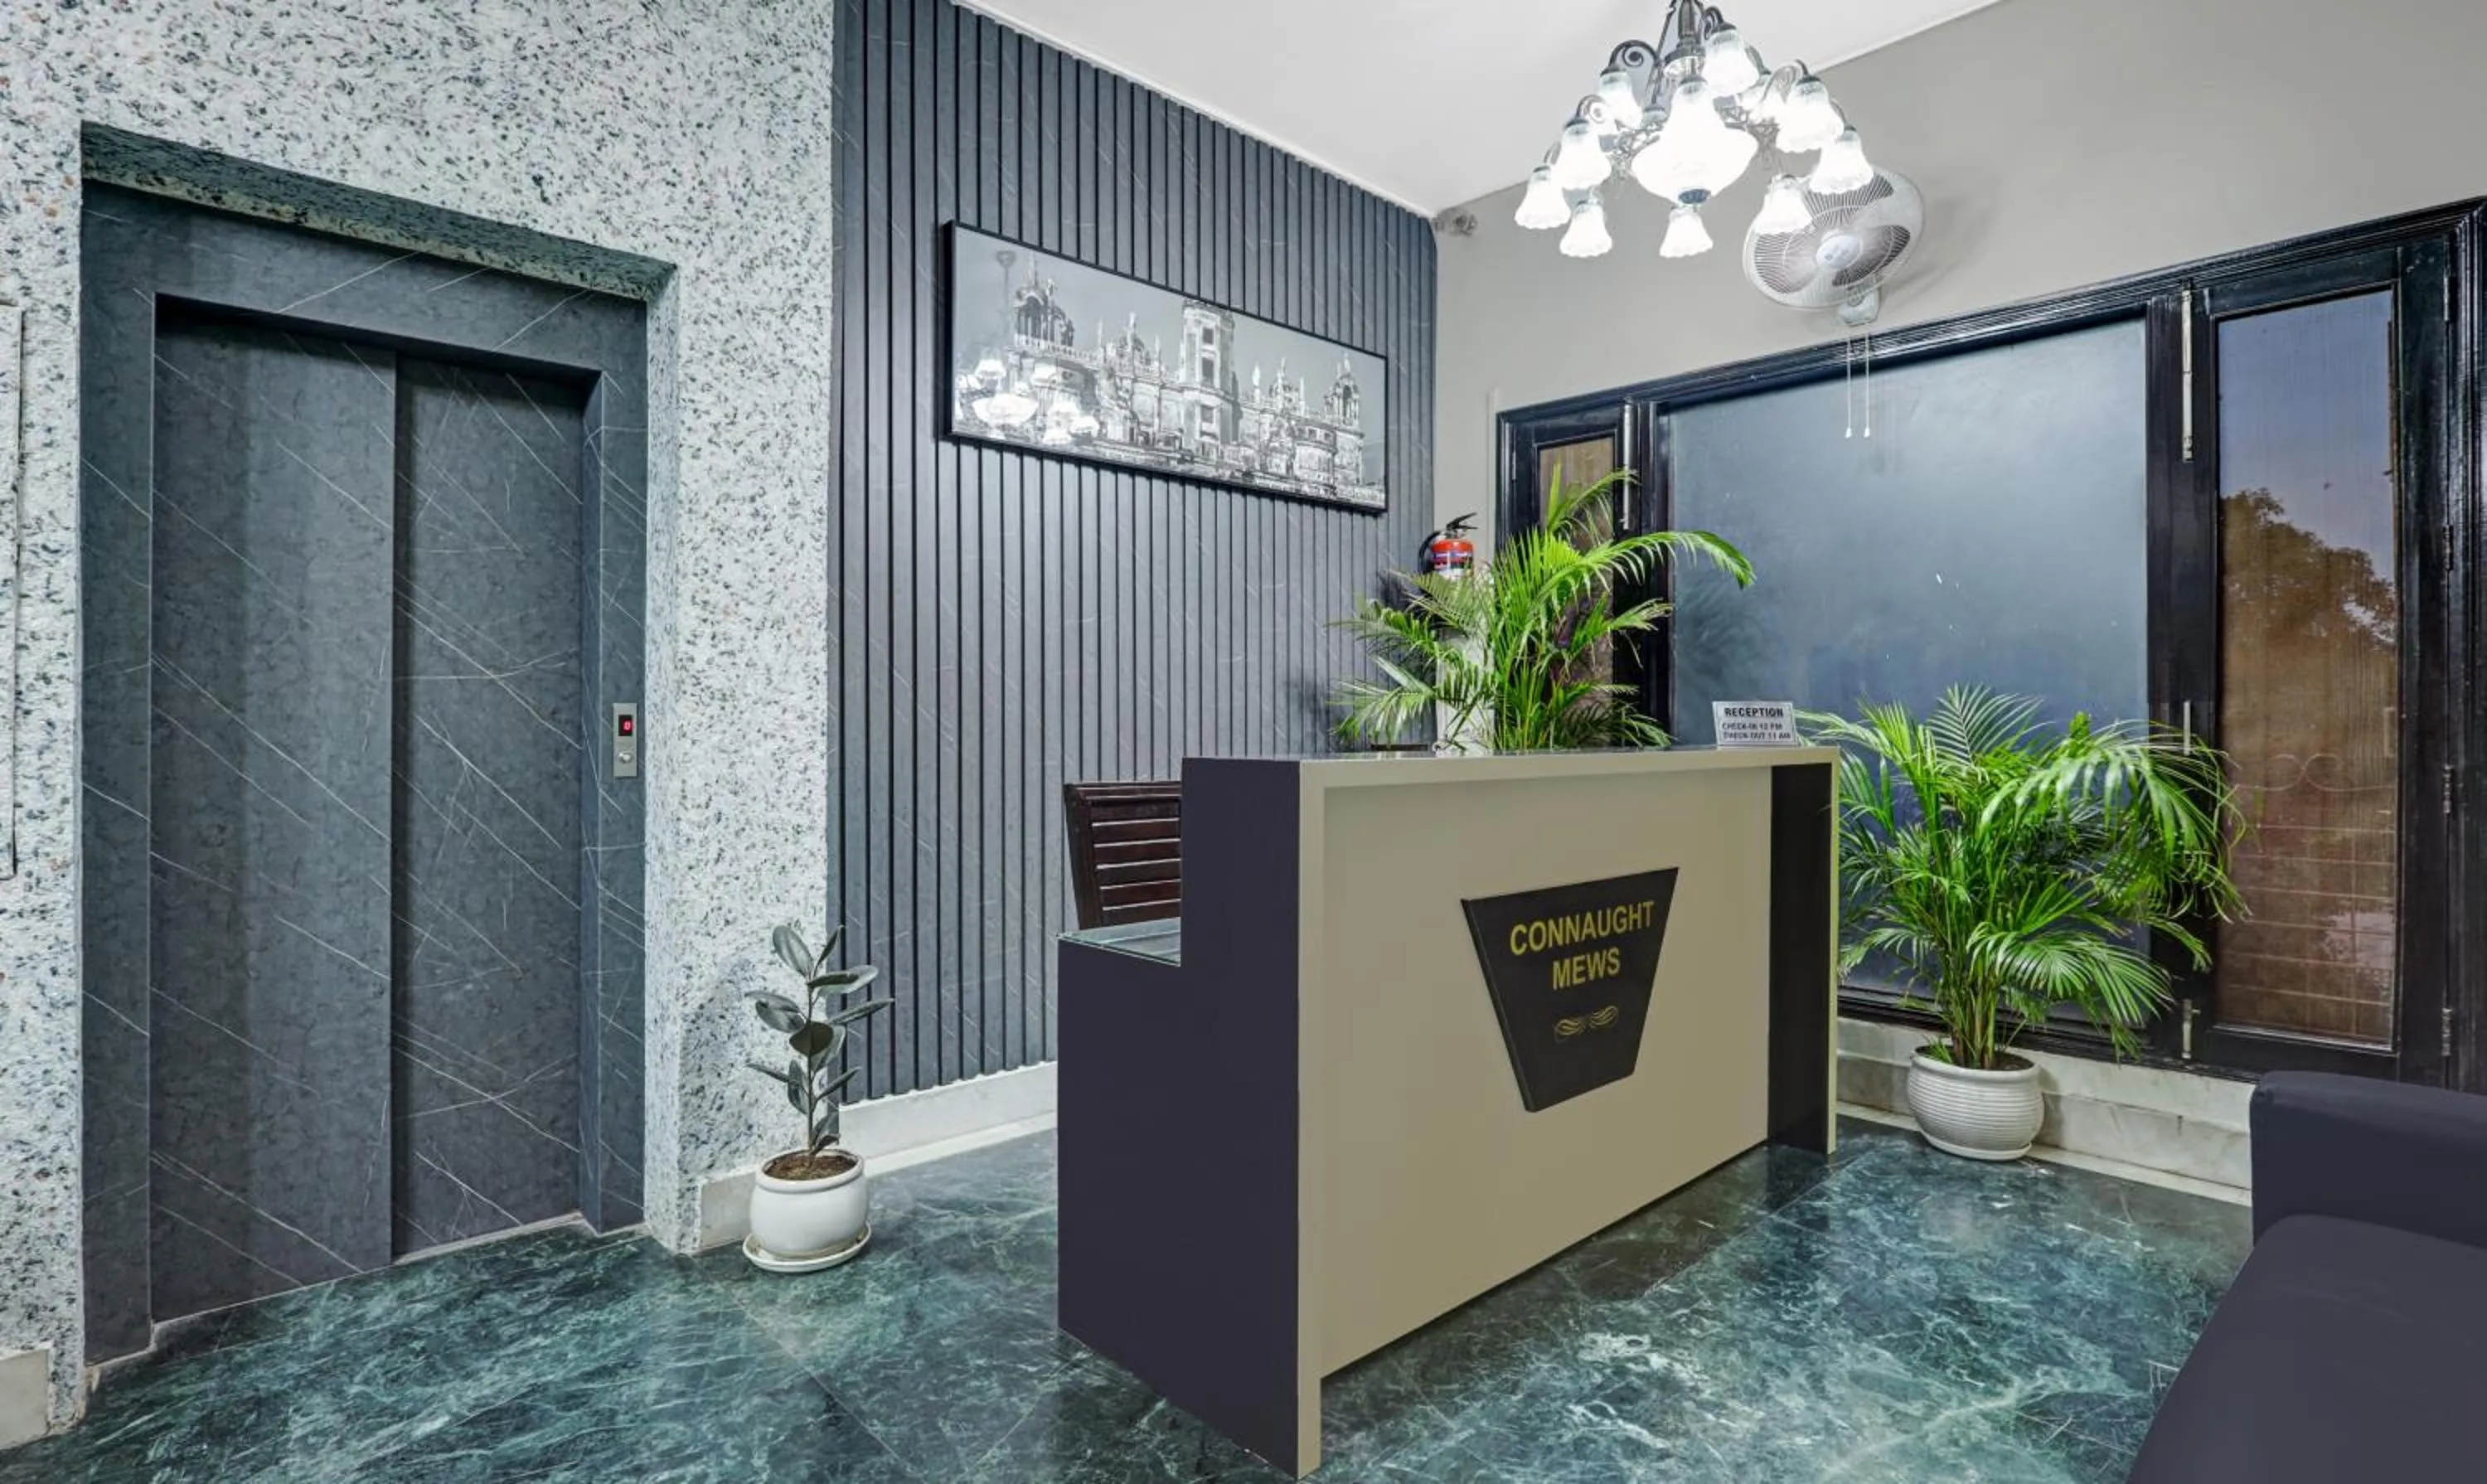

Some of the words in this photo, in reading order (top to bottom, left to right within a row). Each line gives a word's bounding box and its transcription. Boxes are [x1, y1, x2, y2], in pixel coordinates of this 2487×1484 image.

[1724, 707, 1783, 717] RECEPTION
[1770, 722, 1782, 730] PM
[1778, 731, 1791, 740] AM
[1510, 900, 1655, 956] CONNAUGHT
[1553, 948, 1620, 990] MEWS
